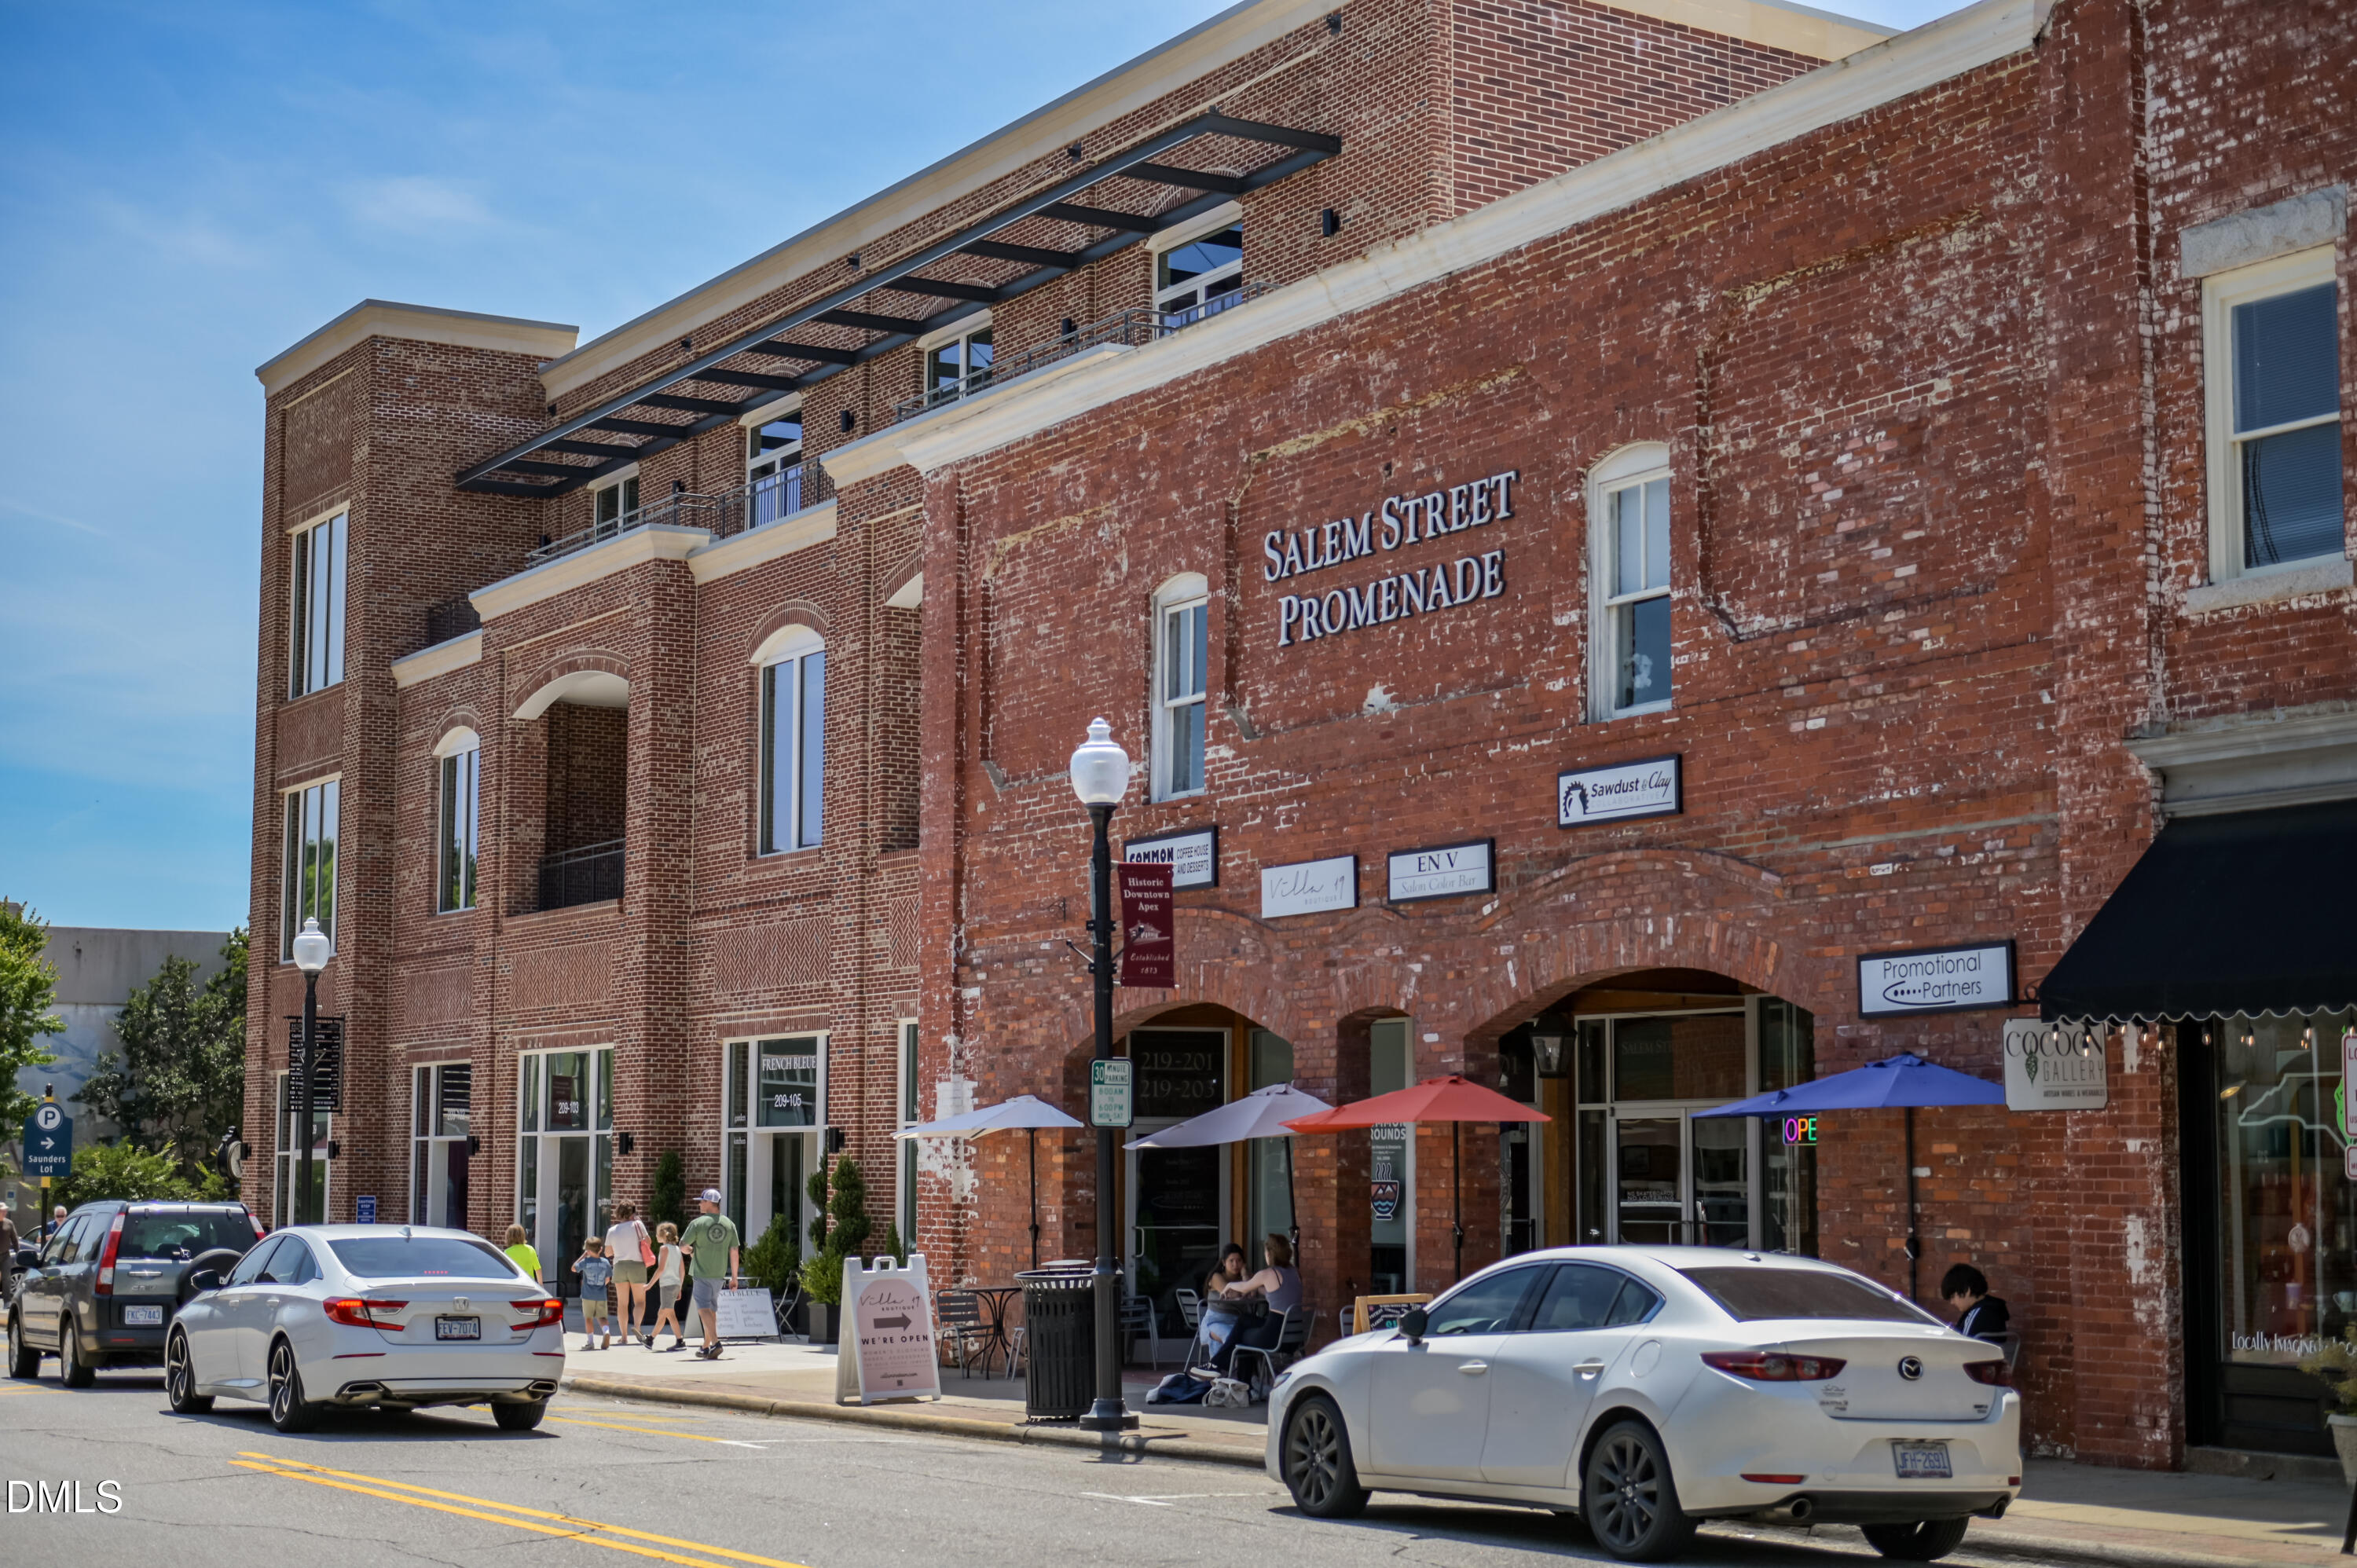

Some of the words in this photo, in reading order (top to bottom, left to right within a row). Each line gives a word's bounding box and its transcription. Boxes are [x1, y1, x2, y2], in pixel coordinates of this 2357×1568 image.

[1263, 511, 1376, 582] SALEM
[1381, 470, 1519, 551] STREET
[1277, 550, 1505, 647] PROMENADE
[1591, 778, 1640, 797] Sawdust
[1648, 771, 1672, 797] Clay
[1129, 847, 1175, 863] COMMON
[1177, 846, 1193, 859] COFFEE
[1194, 844, 1209, 856] HOUSE
[1177, 863, 1186, 874] AND
[1187, 859, 1209, 874] DESSERTS
[1417, 853, 1440, 873] EN
[1446, 852, 1459, 868] V
[1127, 877, 1164, 887] Historic
[1270, 869, 1325, 899] Villa
[1400, 881, 1427, 895] Salon
[1428, 877, 1456, 892] Color
[1458, 874, 1475, 887] Bar
[1124, 889, 1170, 899] Downtown
[1138, 901, 1159, 913] Apex
[1130, 952, 1170, 962] Established
[1883, 951, 1981, 980] Promotional
[1923, 980, 1982, 999] Partners
[2005, 1028, 2104, 1057] COCOON
[762, 1057, 792, 1072] FRENCH
[794, 1055, 816, 1070] BLEUE
[1106, 1064, 1126, 1073] MINUTE
[1140, 1051, 1214, 1072] 219-201
[1094, 1066, 1105, 1082] 30
[2043, 1060, 2104, 1082] GALLERY
[1140, 1080, 1215, 1098] 219-203
[559, 1101, 579, 1114] 209-103
[774, 1094, 801, 1107] 209-105
[44, 1110, 56, 1126] P
[1371, 1127, 1406, 1141] OUNDS
[1785, 1117, 1816, 1141] OPE
[28, 1155, 66, 1163] Saunders
[40, 1165, 53, 1174] Lot
[860, 1292, 904, 1306] Villa
[438, 1323, 478, 1334] FEV-7074
[861, 1336, 894, 1345] WE'RE
[1899, 1451, 1948, 1469] JFH-2691
